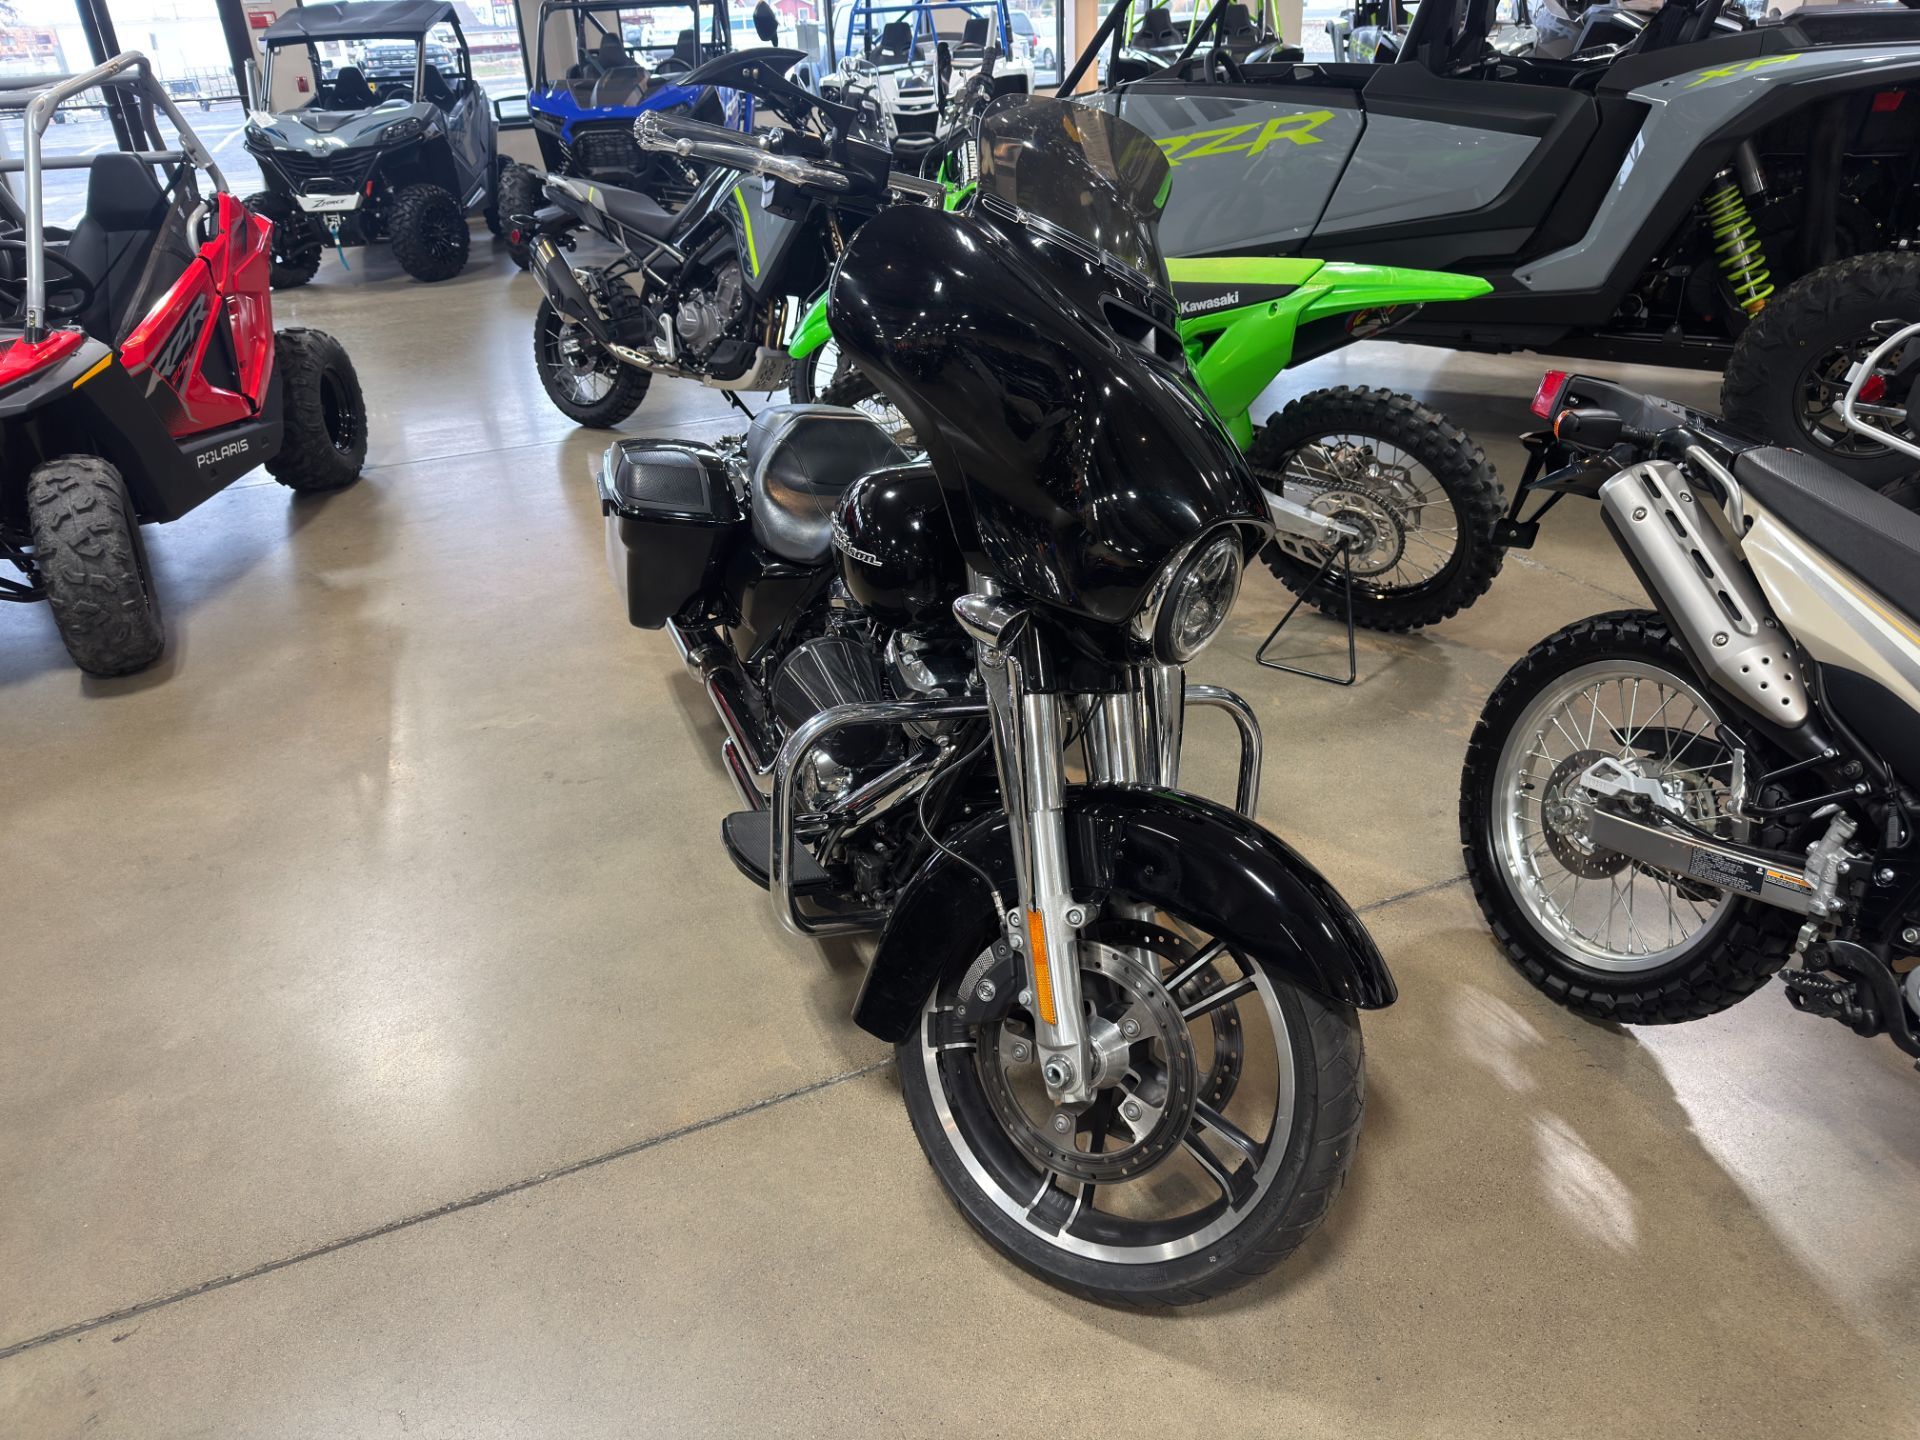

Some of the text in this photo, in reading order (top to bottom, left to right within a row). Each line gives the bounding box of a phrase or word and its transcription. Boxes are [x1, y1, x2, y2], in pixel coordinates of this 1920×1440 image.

[1682, 53, 1802, 88] XP
[1181, 291, 1239, 314] Kawasaki
[144, 293, 209, 399] RZR
[196, 438, 249, 468] POLARIS
